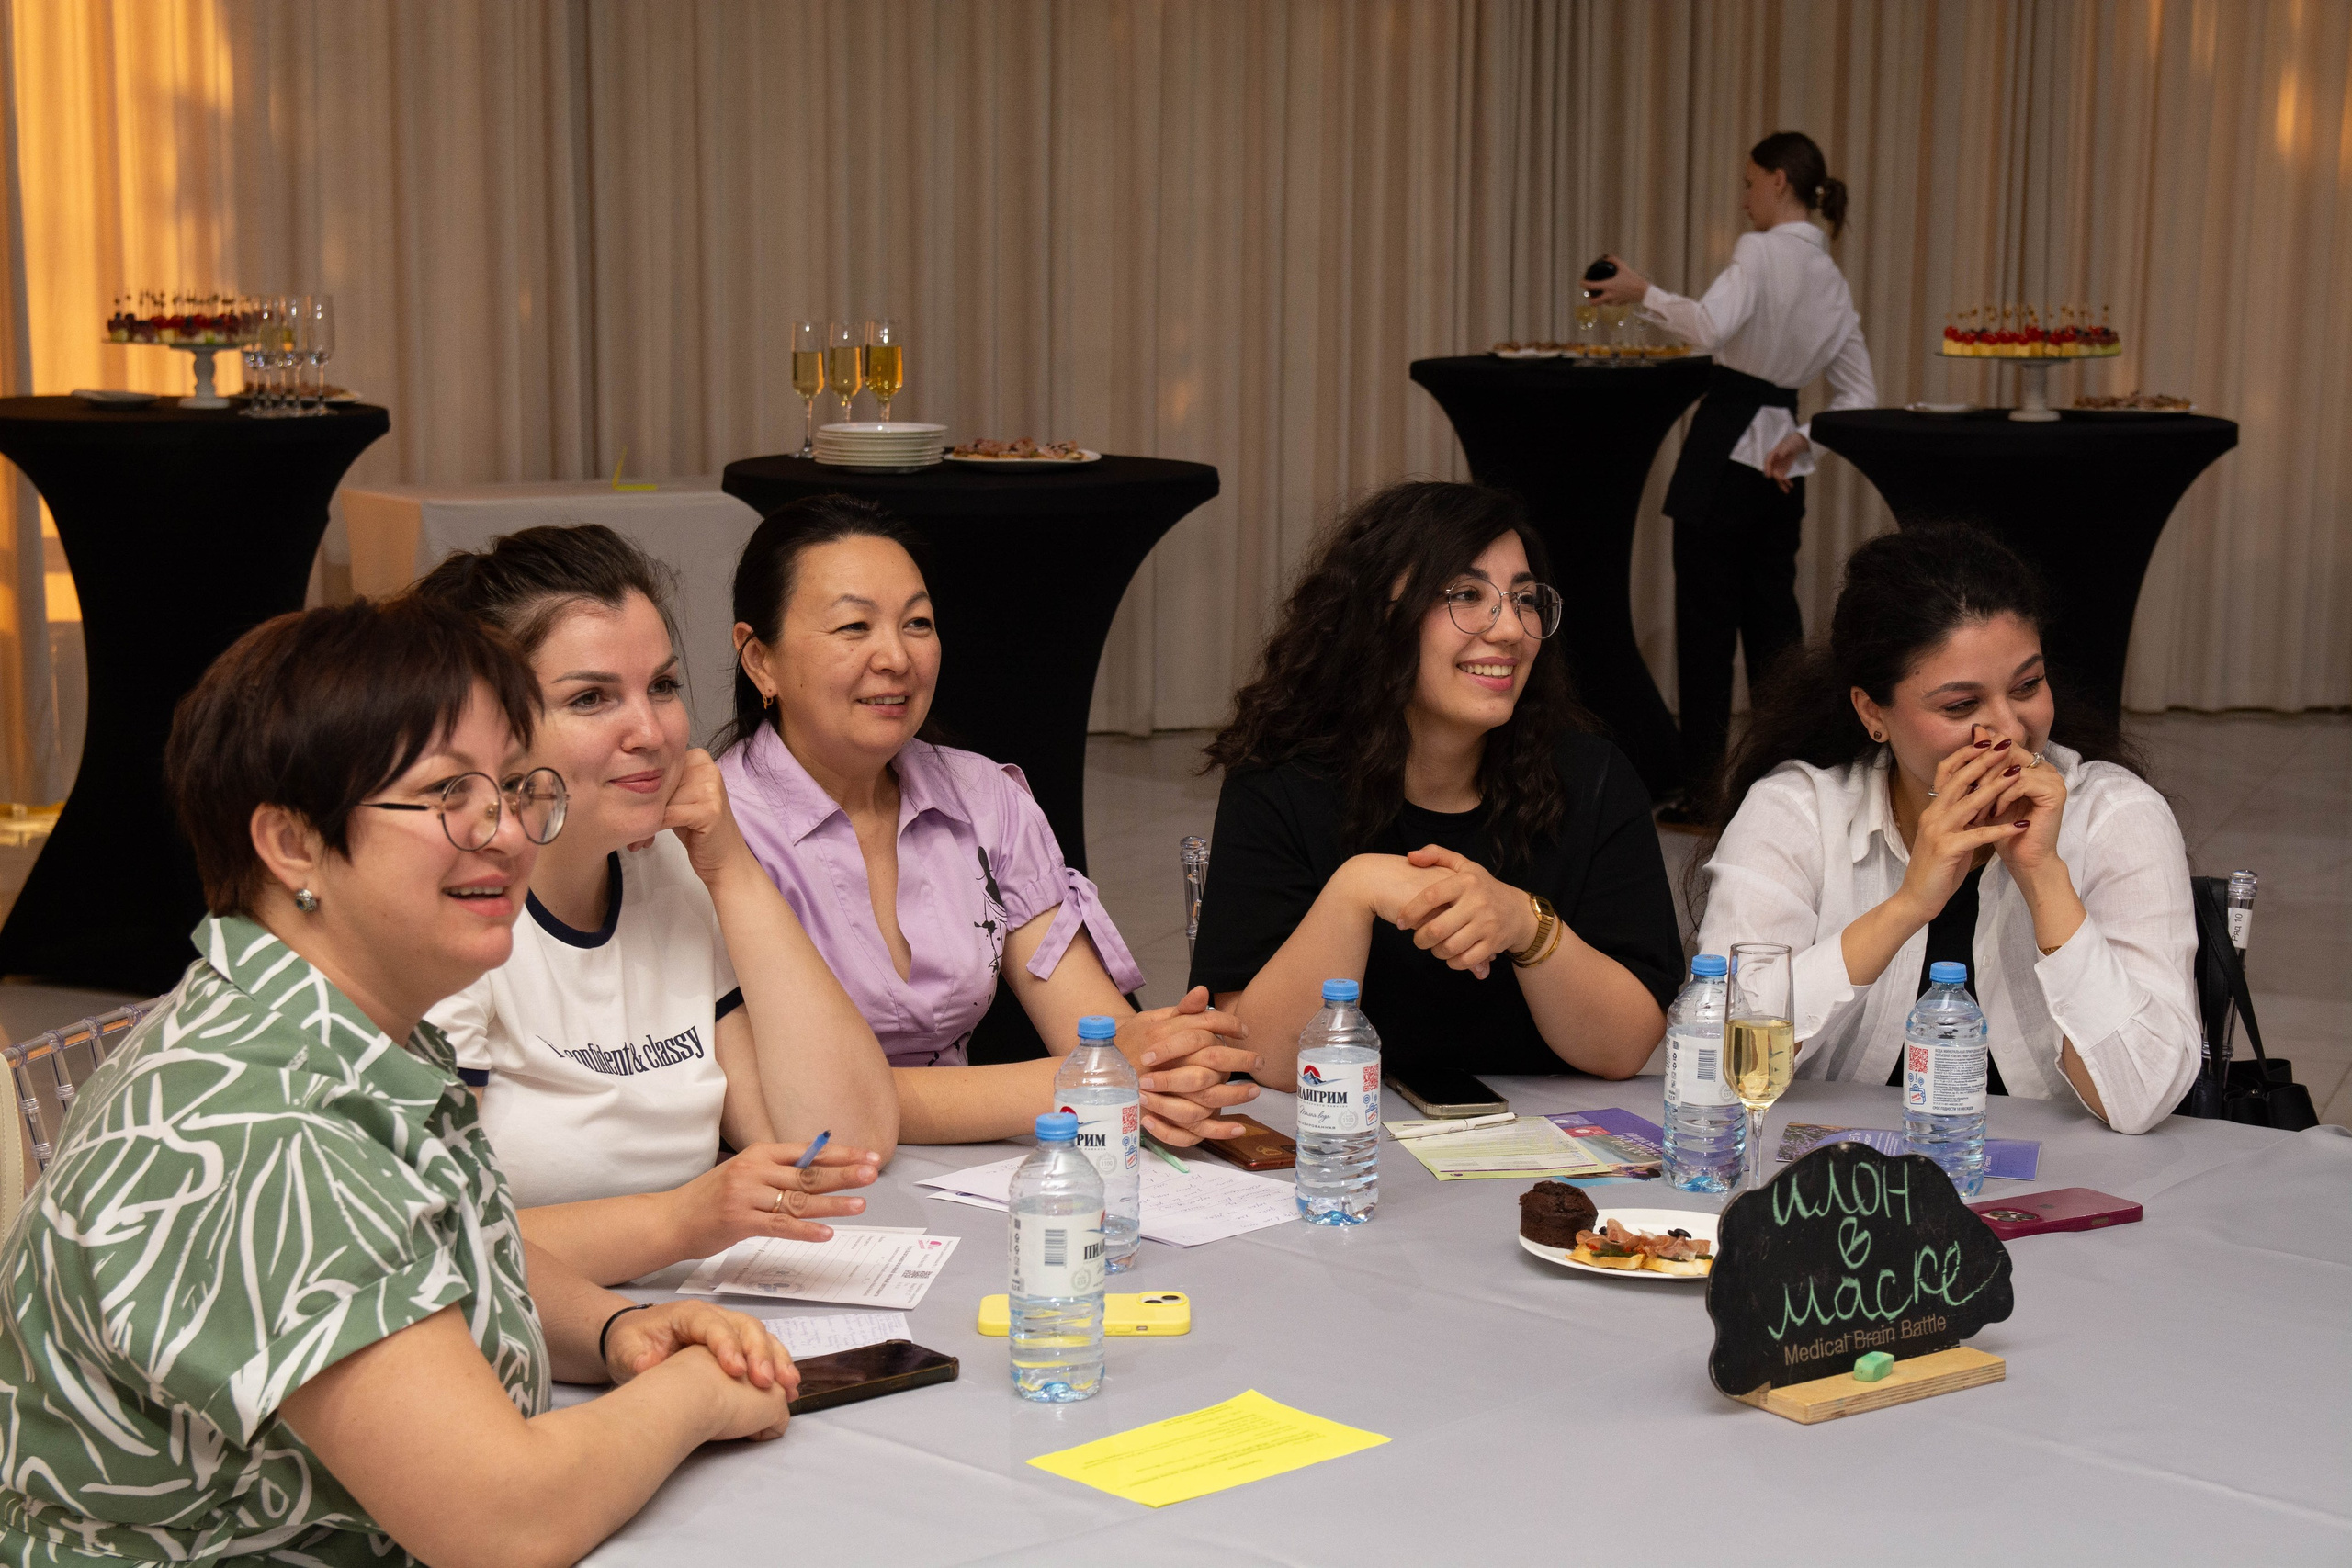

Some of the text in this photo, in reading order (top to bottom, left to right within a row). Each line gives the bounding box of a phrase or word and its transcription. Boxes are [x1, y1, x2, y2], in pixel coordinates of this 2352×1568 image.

[2231, 913, 2244, 942] Ряд 10
[643, 1025, 705, 1068] classy
[1297, 1085, 1348, 1104] ИЛИГРИМ
[1076, 1134, 1106, 1147] РИМ
[1783, 1314, 1947, 1366] Medical Brain Battle
